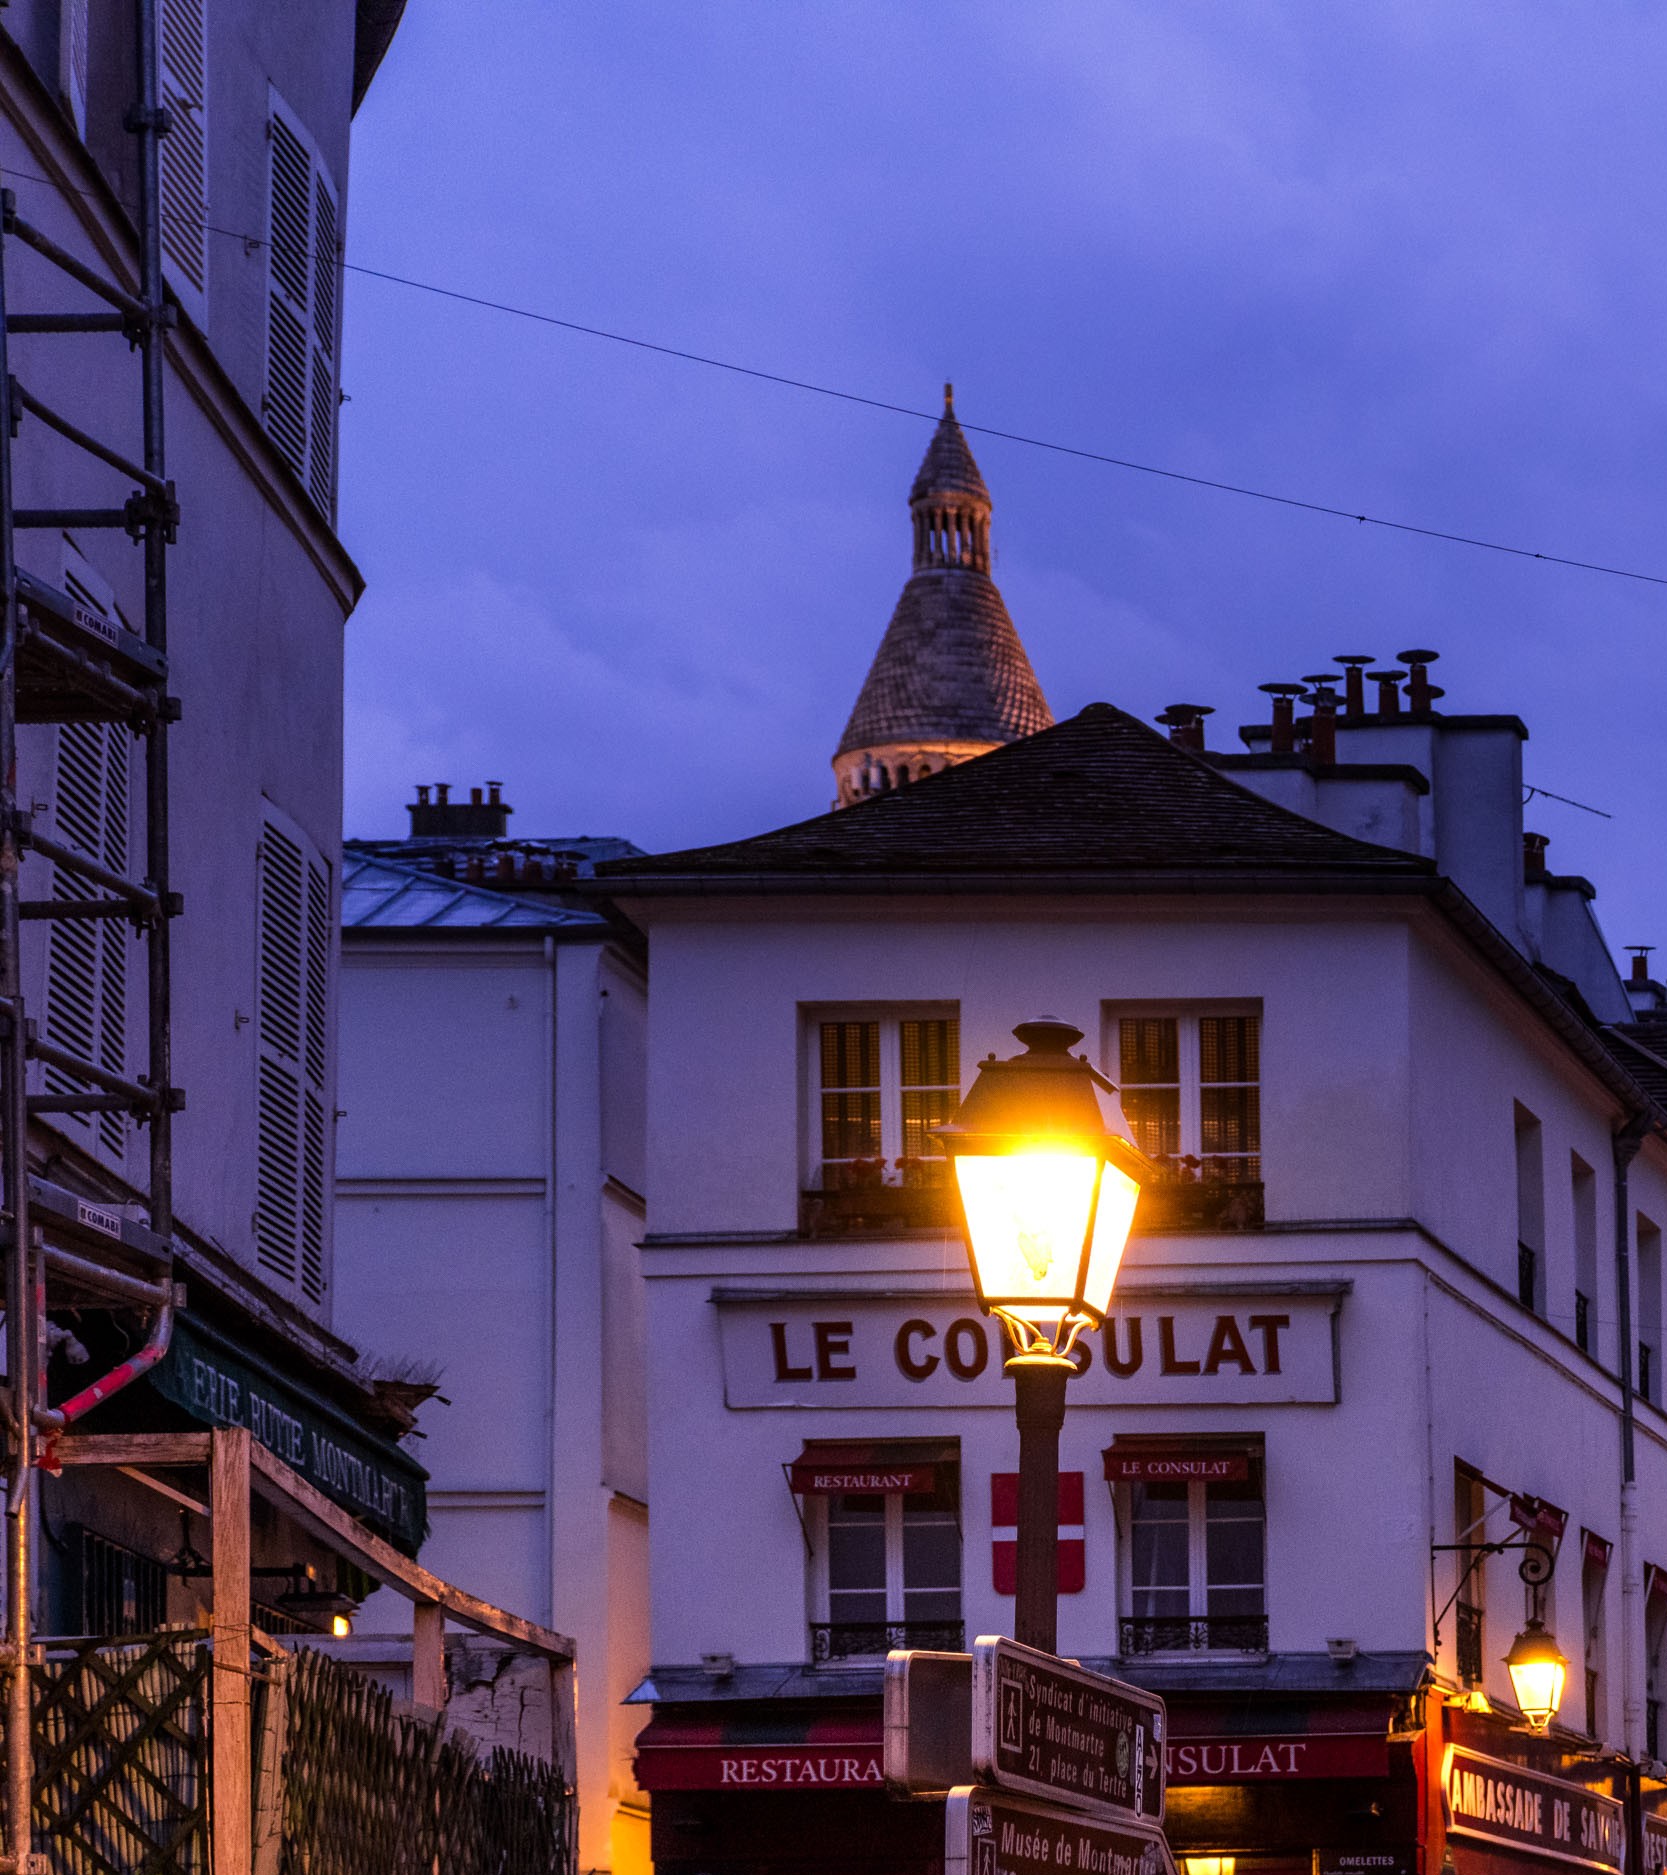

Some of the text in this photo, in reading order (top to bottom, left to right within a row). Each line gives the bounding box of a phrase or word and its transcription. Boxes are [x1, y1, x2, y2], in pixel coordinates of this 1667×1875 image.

[771, 1322, 856, 1382] LE
[814, 1474, 912, 1488] RESTAURANT
[1122, 1461, 1230, 1474] LE CONSULAT
[1028, 1674, 1133, 1735] Syndicat d'initiative
[1028, 1710, 1105, 1757] de Montmartre
[1051, 1753, 1078, 1783] place
[1083, 1762, 1094, 1789] du
[1099, 1767, 1127, 1798] Tertre
[1452, 1768, 1543, 1835] AMBASSADE
[1553, 1798, 1571, 1842] DE
[1001, 1821, 1049, 1862] Musée
[1055, 1834, 1072, 1866] de
[1339, 1856, 1395, 1867] OMELETTES
